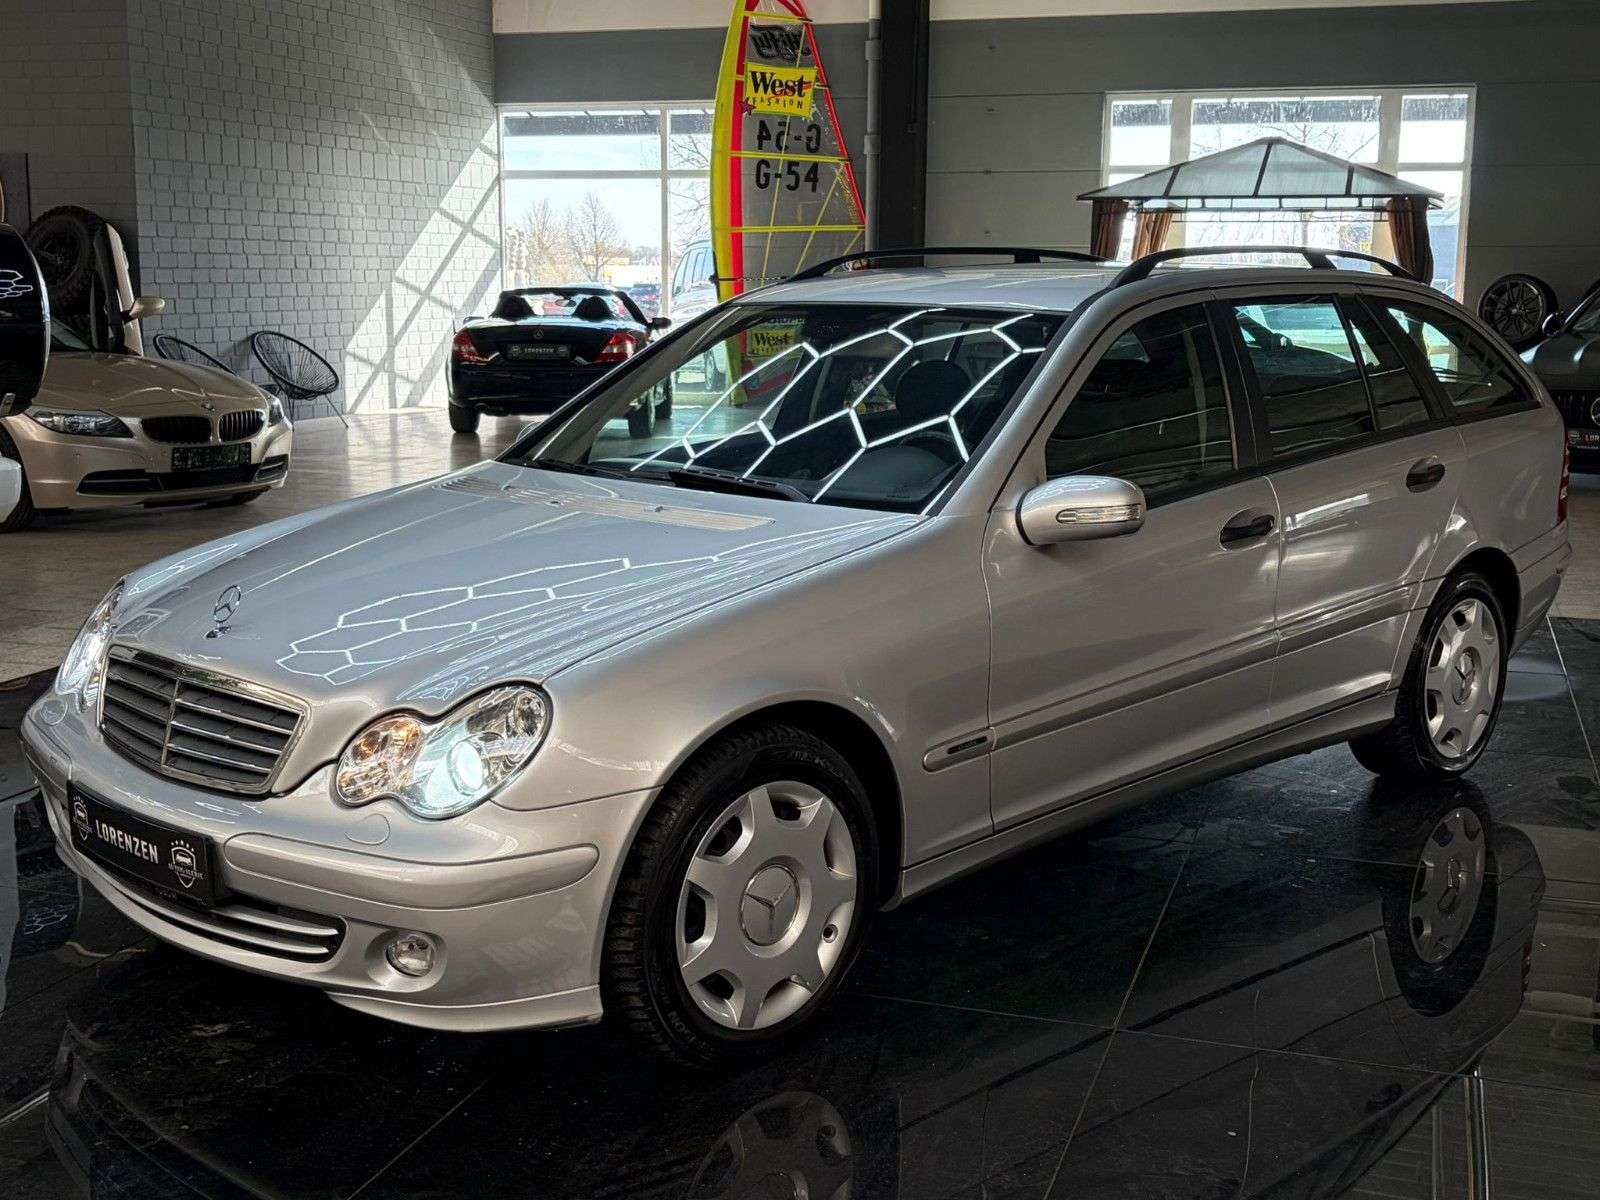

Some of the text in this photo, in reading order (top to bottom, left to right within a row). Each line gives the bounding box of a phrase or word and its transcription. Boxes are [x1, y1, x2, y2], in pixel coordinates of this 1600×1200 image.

[751, 71, 810, 97] West
[753, 97, 803, 109] FASHION
[755, 159, 819, 192] G-54
[754, 332, 791, 346] West
[95, 819, 158, 864] LORENZEN
